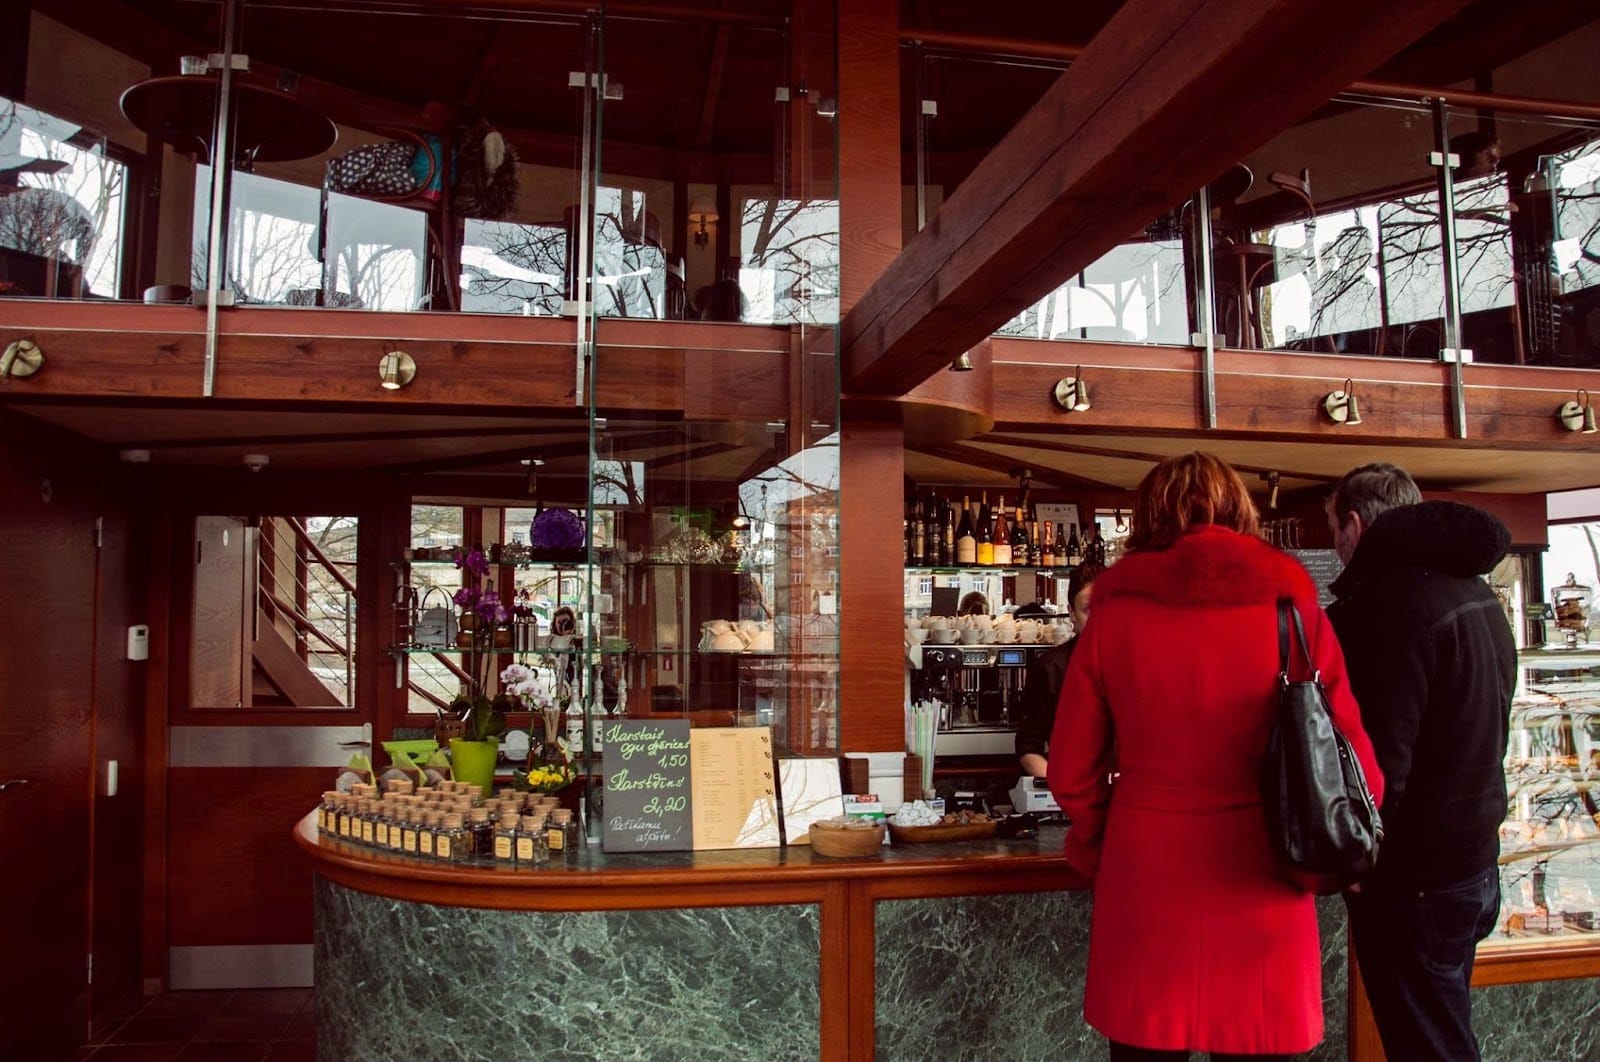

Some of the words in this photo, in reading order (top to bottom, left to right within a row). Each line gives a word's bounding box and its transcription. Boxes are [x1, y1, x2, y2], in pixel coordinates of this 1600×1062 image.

[606, 724, 664, 743] Karstais
[620, 742, 644, 760] ogu
[658, 754, 687, 769] 1,50
[643, 796, 686, 817] 2,20
